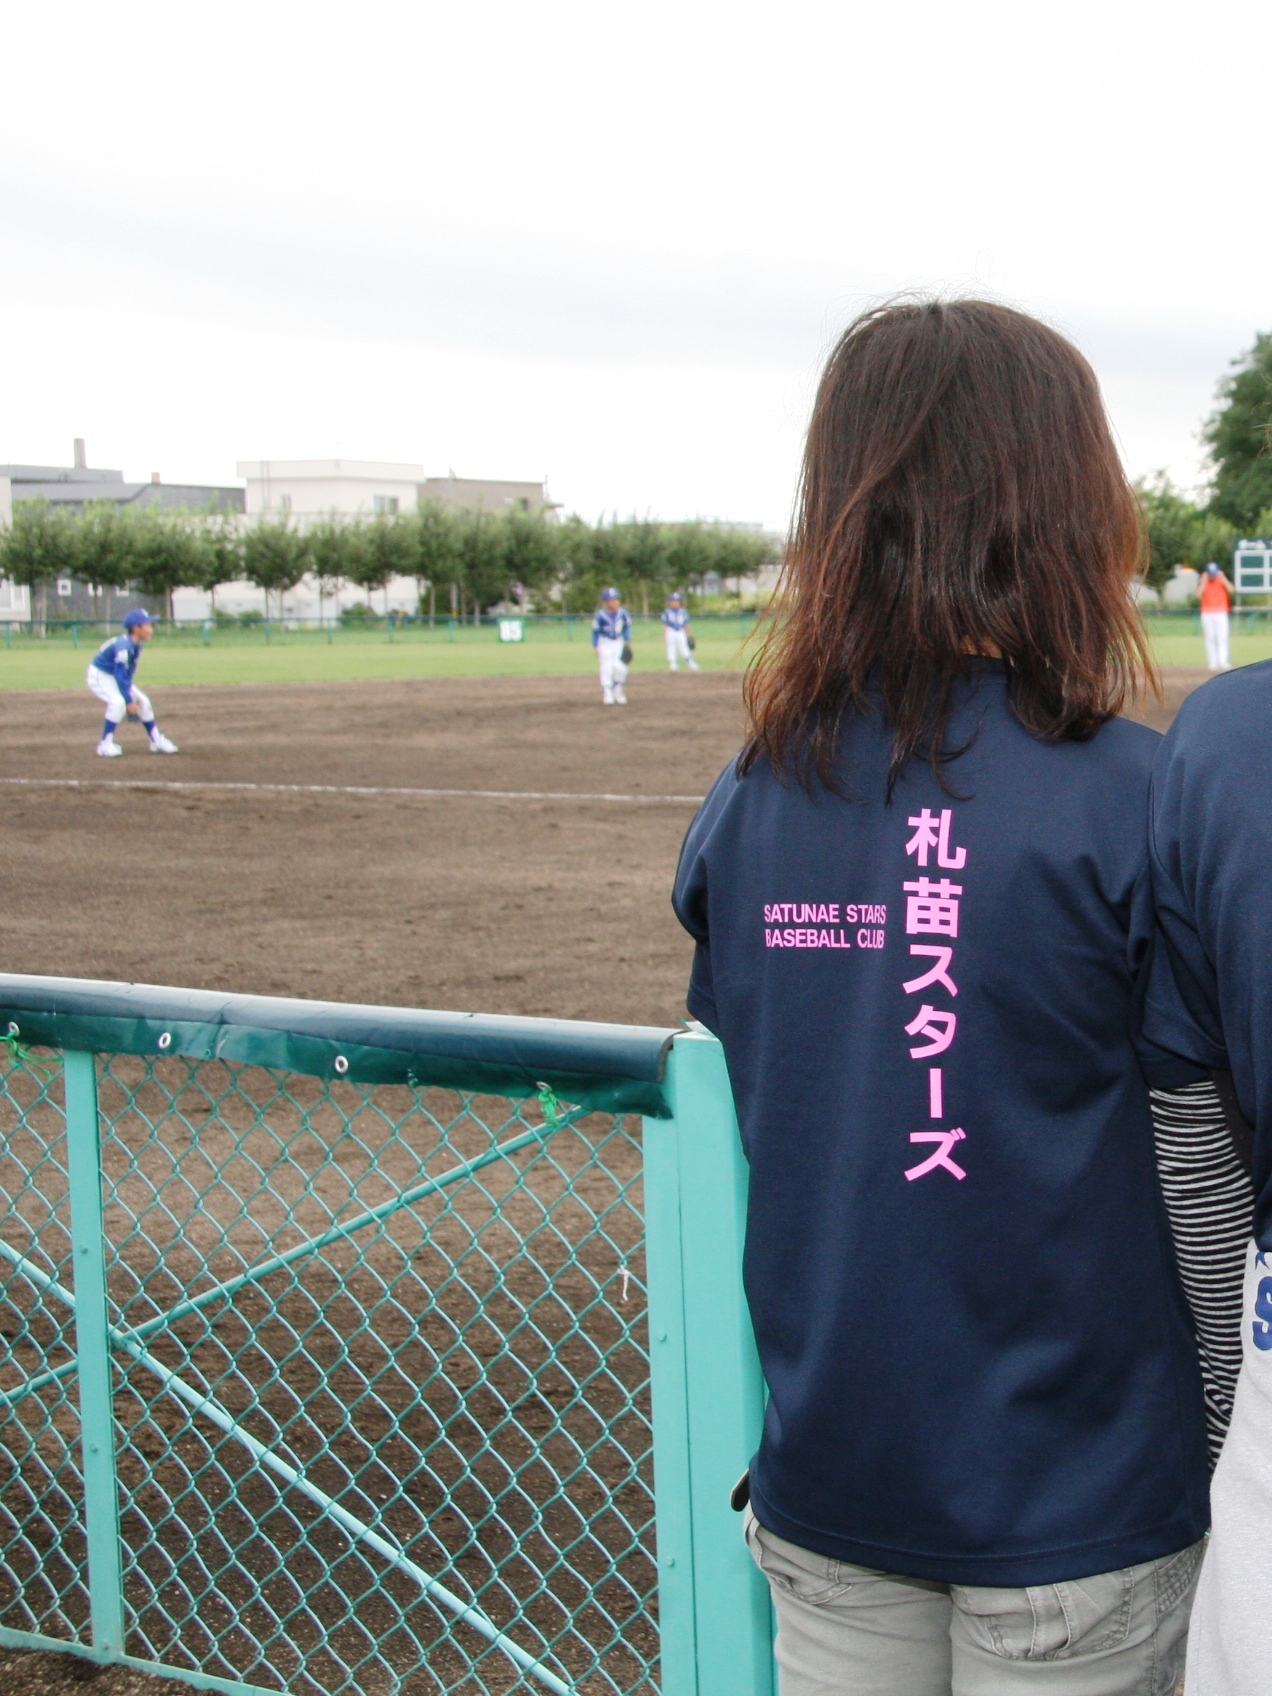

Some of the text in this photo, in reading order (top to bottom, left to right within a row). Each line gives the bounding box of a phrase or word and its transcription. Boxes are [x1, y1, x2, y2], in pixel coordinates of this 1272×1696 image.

[500, 620, 523, 642] 85
[764, 903, 887, 925] SATUNAE STARS
[765, 928, 885, 949] BASEBALL CLUB
[902, 808, 967, 1182] 札苗スターズ
